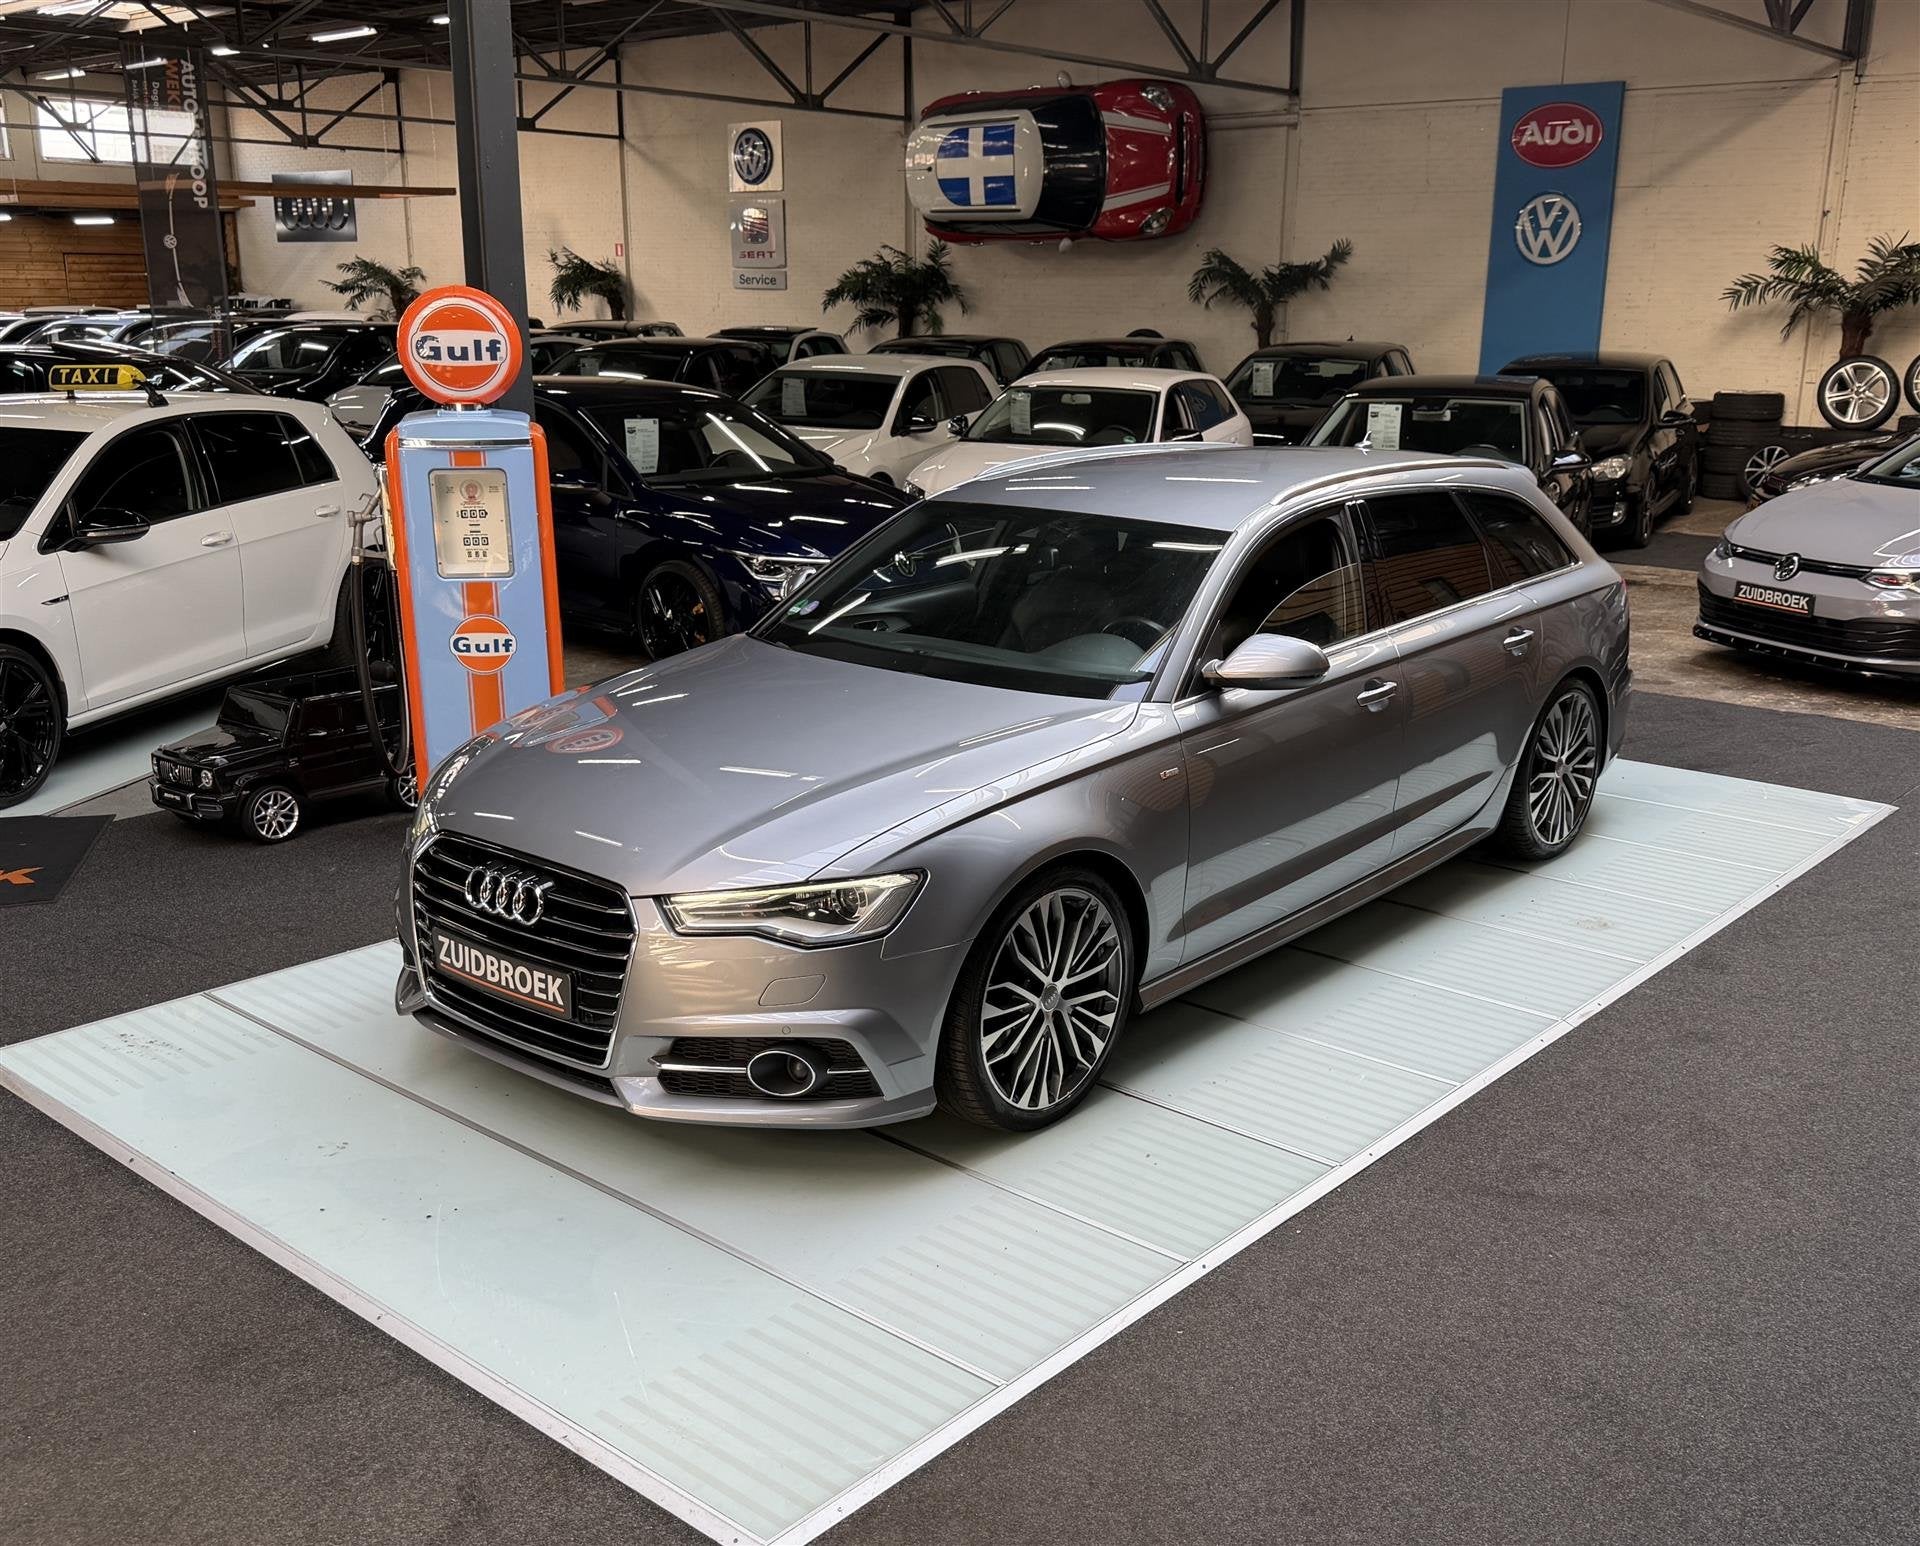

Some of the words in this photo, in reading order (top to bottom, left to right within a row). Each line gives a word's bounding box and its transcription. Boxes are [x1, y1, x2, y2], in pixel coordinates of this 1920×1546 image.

[180, 58, 209, 209] AUTOOOP
[739, 250, 776, 259] SEAT
[739, 273, 777, 286] Service
[415, 335, 502, 361] Gulf
[59, 368, 110, 384] TAXI
[1738, 585, 1810, 610] ZUIDBROEK
[453, 636, 513, 653] Gulf
[438, 935, 564, 1005] ZUIDBROEK
